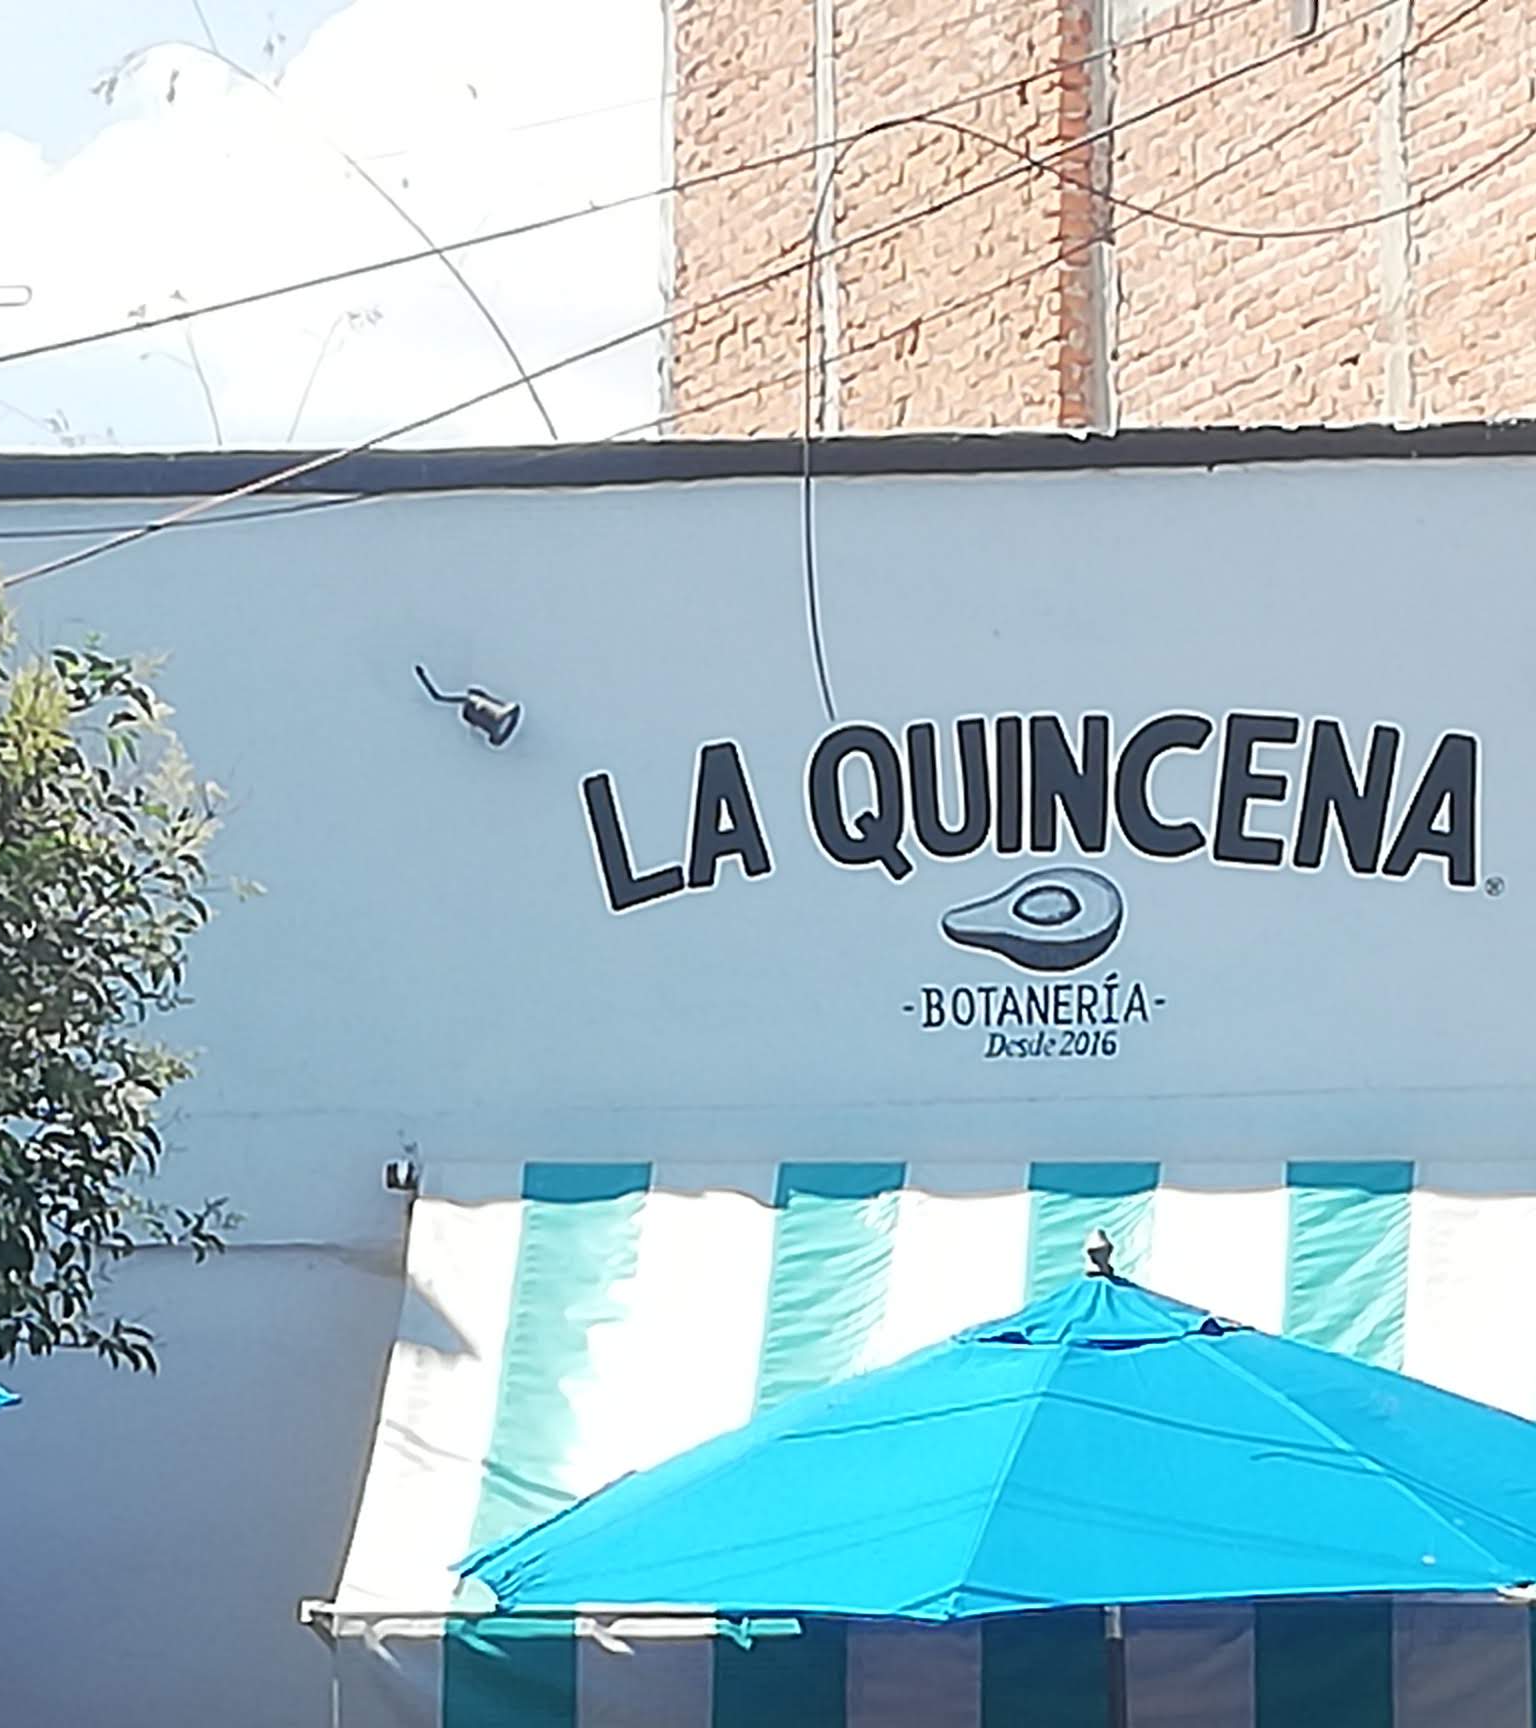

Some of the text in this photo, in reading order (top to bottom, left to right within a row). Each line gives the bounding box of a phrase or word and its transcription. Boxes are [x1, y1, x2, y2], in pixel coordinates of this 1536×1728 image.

[580, 712, 1479, 912] LA QUINCENA
[983, 1030, 1118, 1059] Desde 2016
